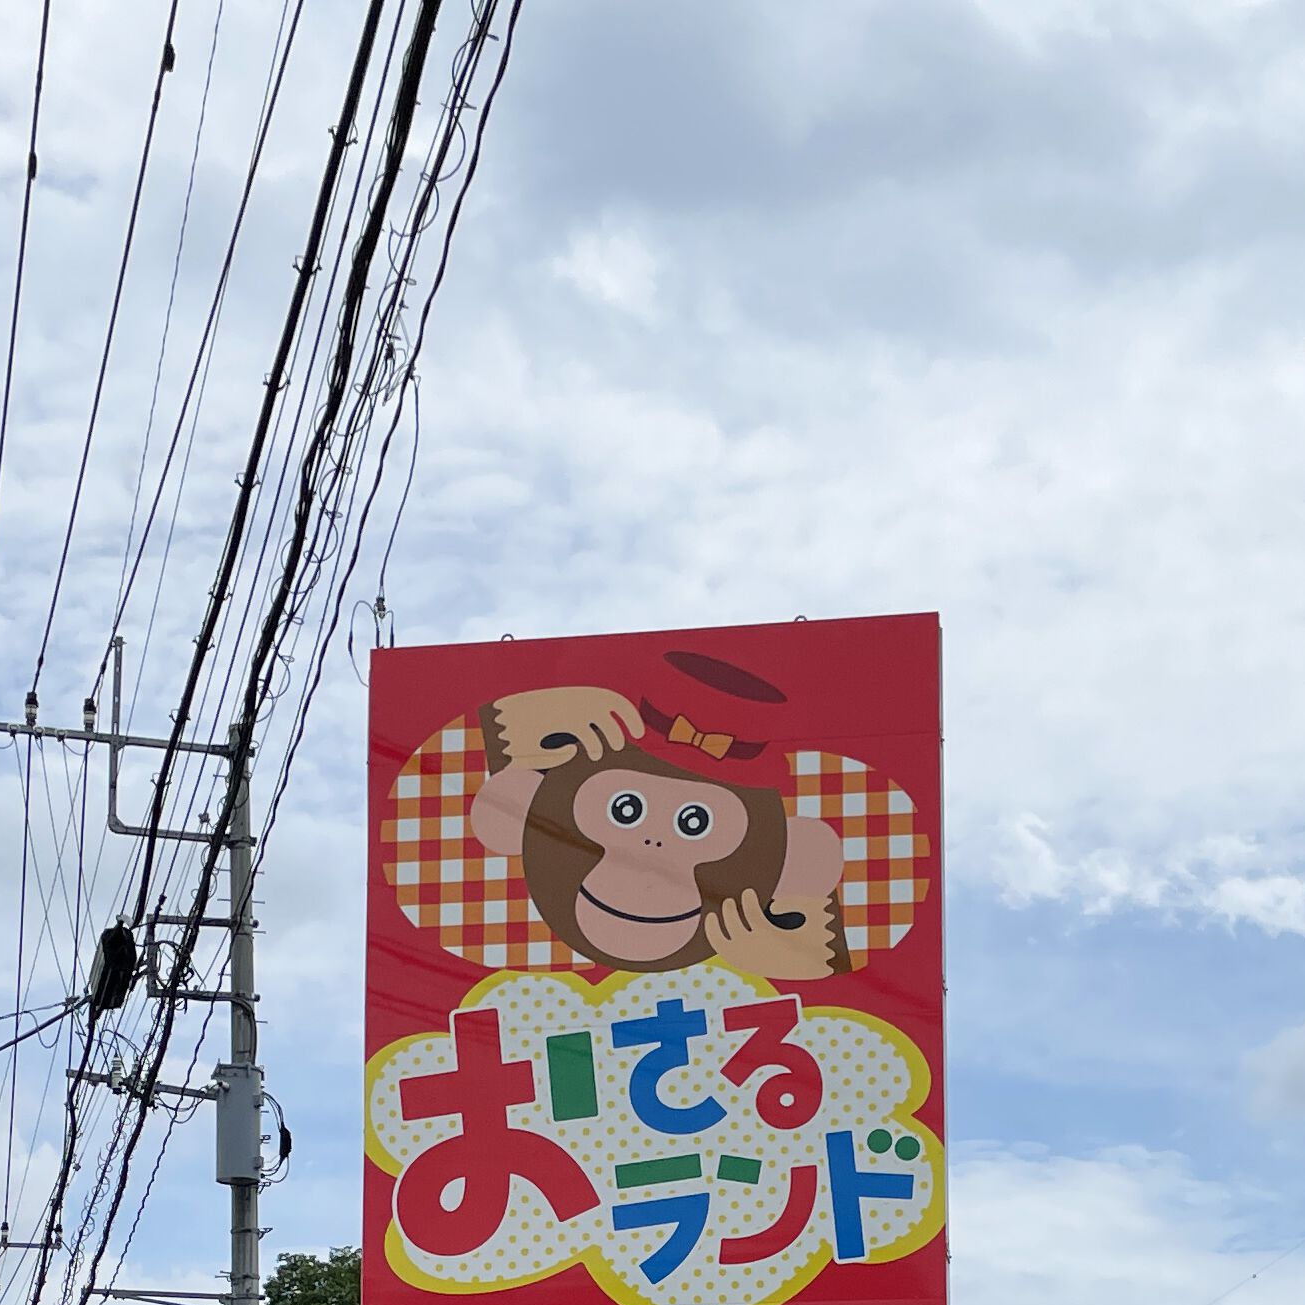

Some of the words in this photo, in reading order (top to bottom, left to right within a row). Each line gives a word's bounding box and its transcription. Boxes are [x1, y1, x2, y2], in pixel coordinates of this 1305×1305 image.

[396, 997, 823, 1257] おさる
[612, 1128, 920, 1285] ランド
